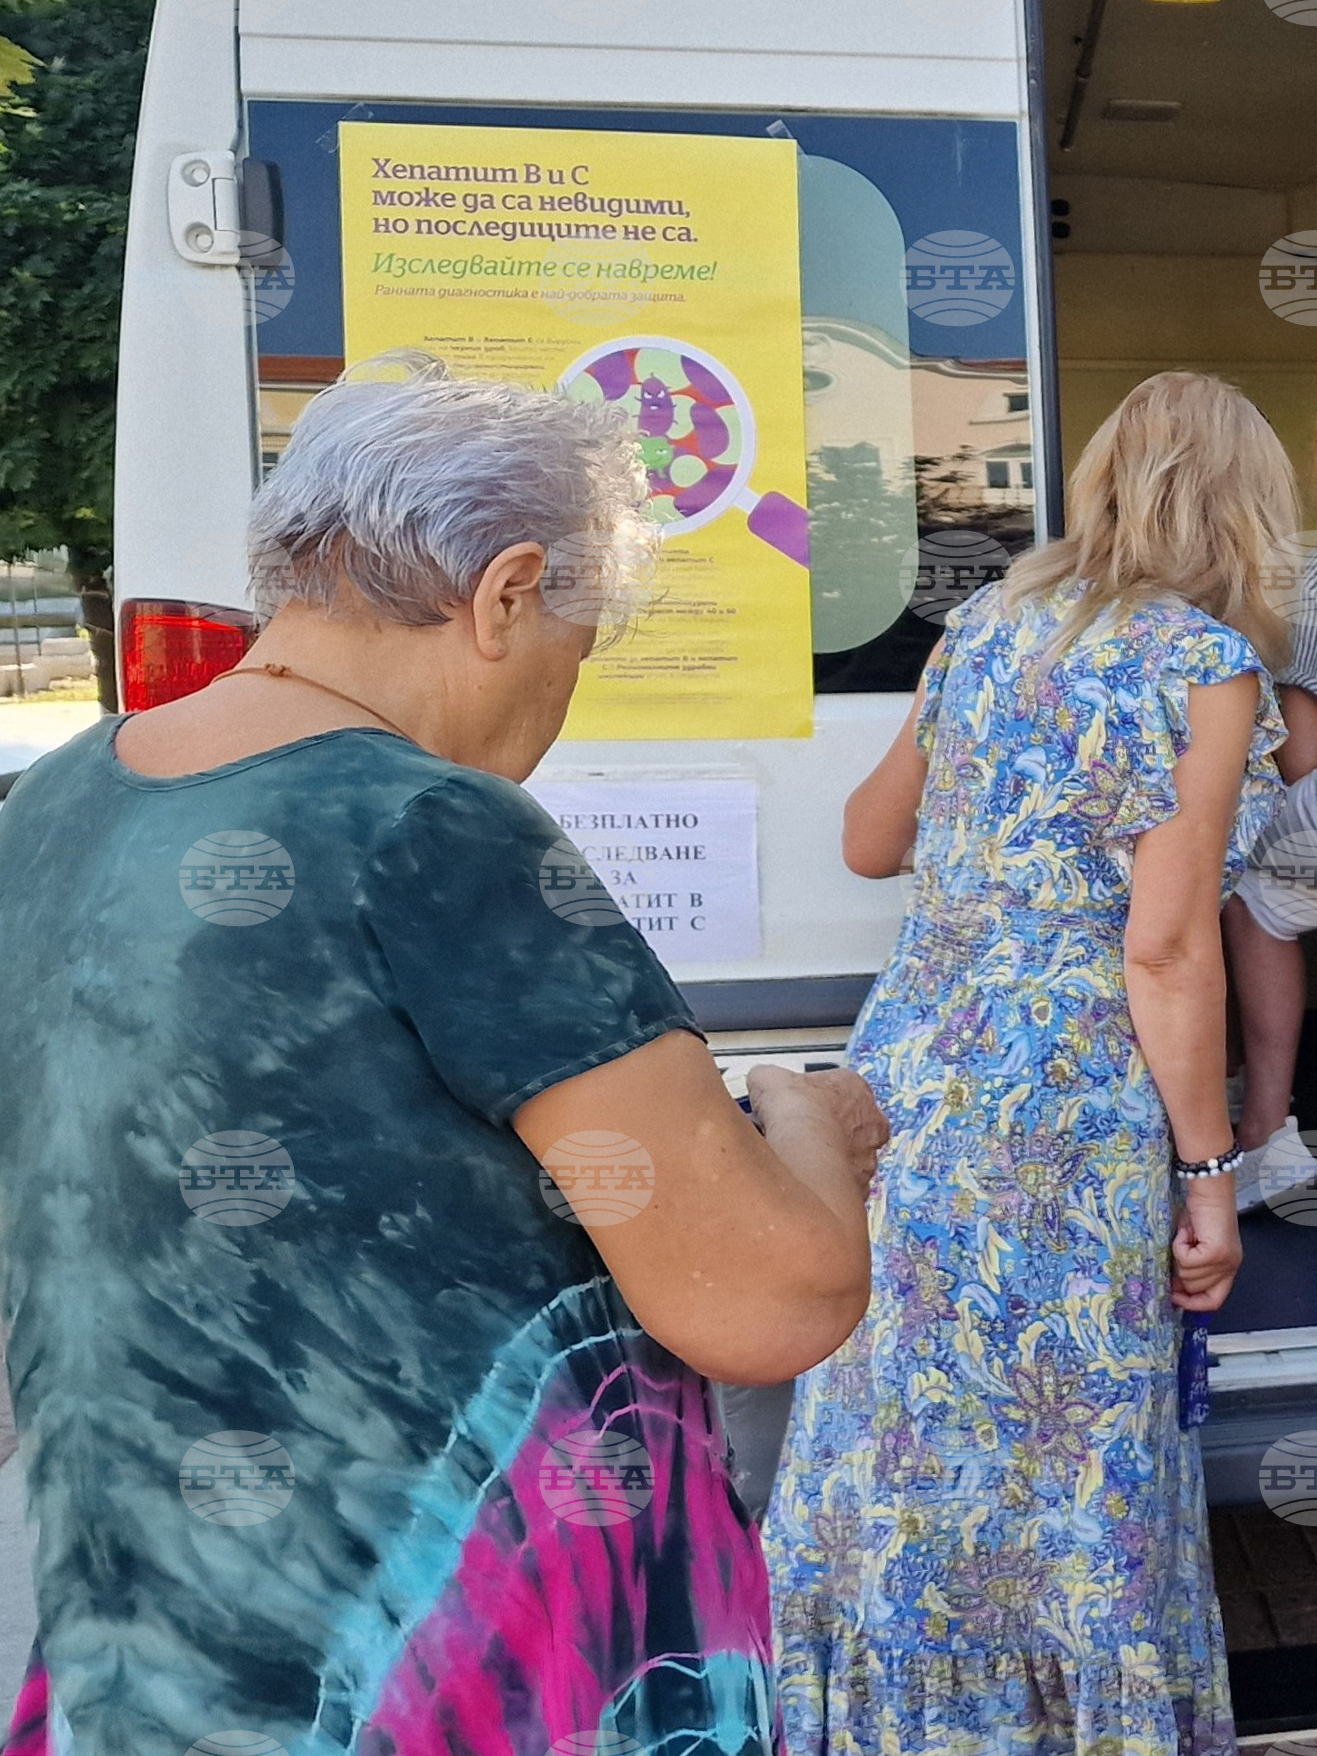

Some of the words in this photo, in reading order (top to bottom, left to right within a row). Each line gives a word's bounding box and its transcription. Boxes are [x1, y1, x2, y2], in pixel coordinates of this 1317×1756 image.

[372, 158, 518, 184] Хепатит
[547, 168, 565, 185] и
[372, 187, 456, 208] може
[462, 191, 496, 213] да
[501, 193, 533, 211] са
[538, 191, 691, 218] невидими,
[372, 217, 409, 234] но
[415, 217, 617, 242] последиците
[622, 224, 656, 241] не
[662, 225, 698, 242] са.
[371, 252, 557, 279] Изследвайте
[562, 260, 591, 278] се
[596, 258, 718, 283] навреме!
[375, 284, 436, 297] Ранната
[438, 286, 529, 300] диагностика
[531, 290, 539, 299] е
[559, 813, 699, 829] БЕЗПЛАТНО
[582, 845, 707, 863] СЛЕДВАНЕ
[609, 869, 638, 885] ЗА
[618, 892, 678, 909] АТИТ
